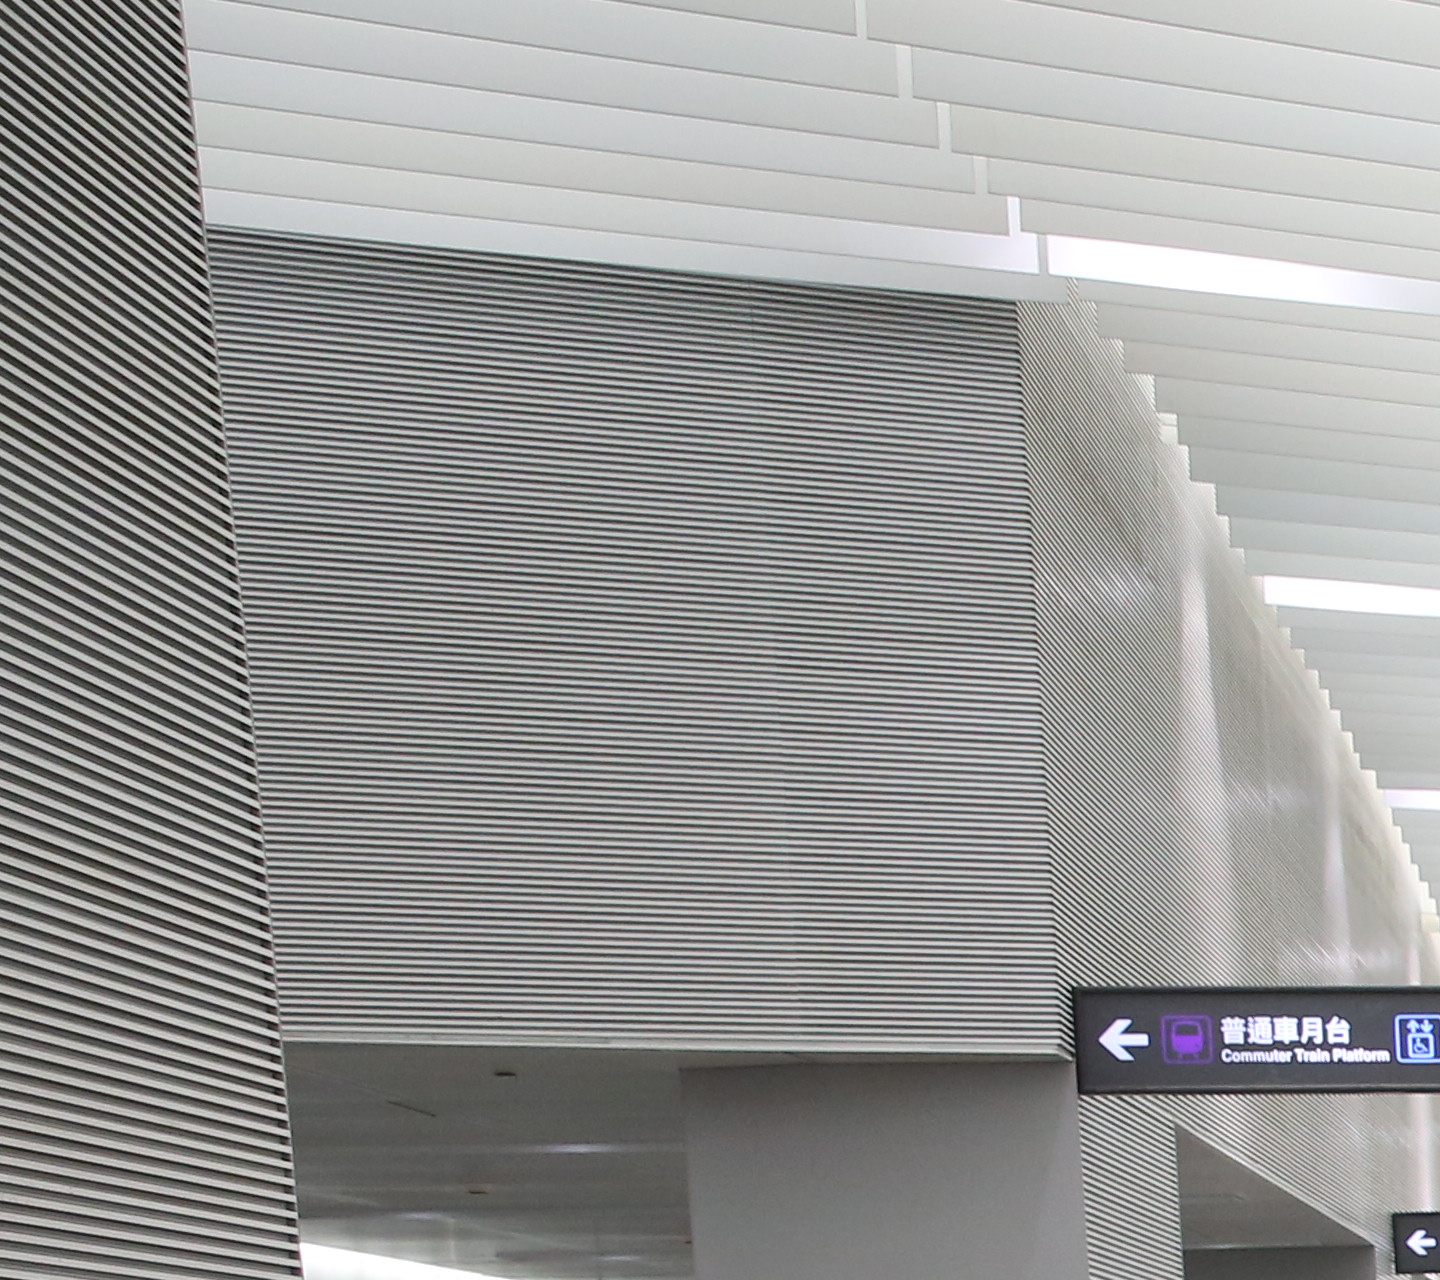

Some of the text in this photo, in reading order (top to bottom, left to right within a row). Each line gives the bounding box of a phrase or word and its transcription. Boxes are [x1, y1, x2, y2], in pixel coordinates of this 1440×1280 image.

[1220, 1016, 1351, 1045] 普通車月台
[1221, 1048, 1391, 1063] Commuter Train Platform
